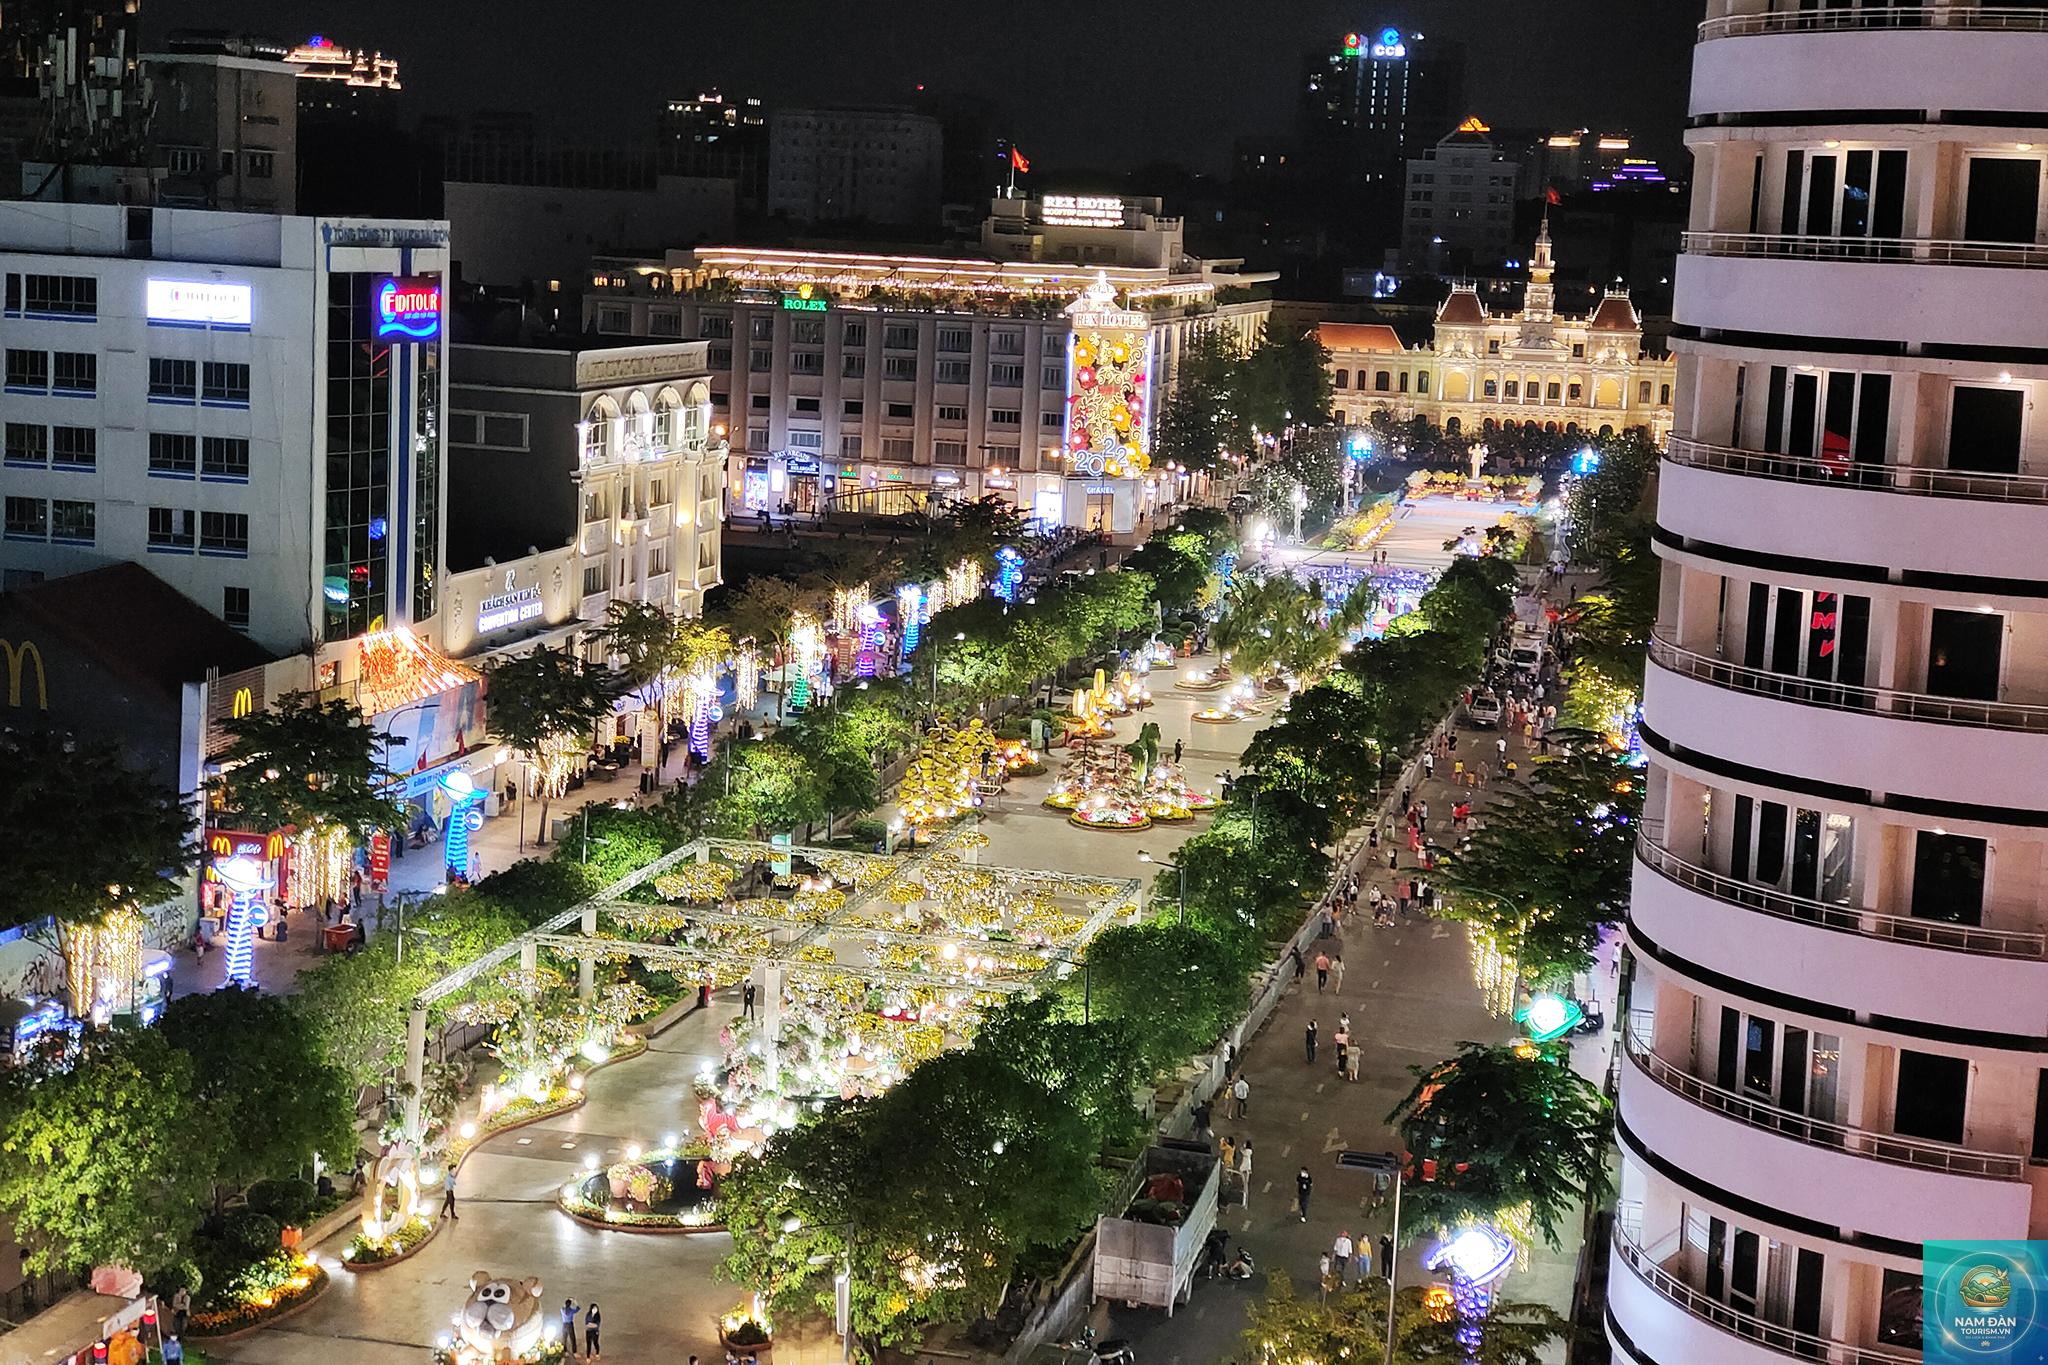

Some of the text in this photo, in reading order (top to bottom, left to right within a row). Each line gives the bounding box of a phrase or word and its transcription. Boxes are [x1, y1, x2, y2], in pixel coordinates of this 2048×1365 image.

[1043, 196, 1124, 210] REX HOTEL
[385, 292, 438, 314] FIDITOUR
[784, 299, 827, 312] ROLEX
[1076, 313, 1147, 328] REX HOTEL
[1087, 486, 1114, 494] CHANEL
[520, 601, 543, 621] CENTER
